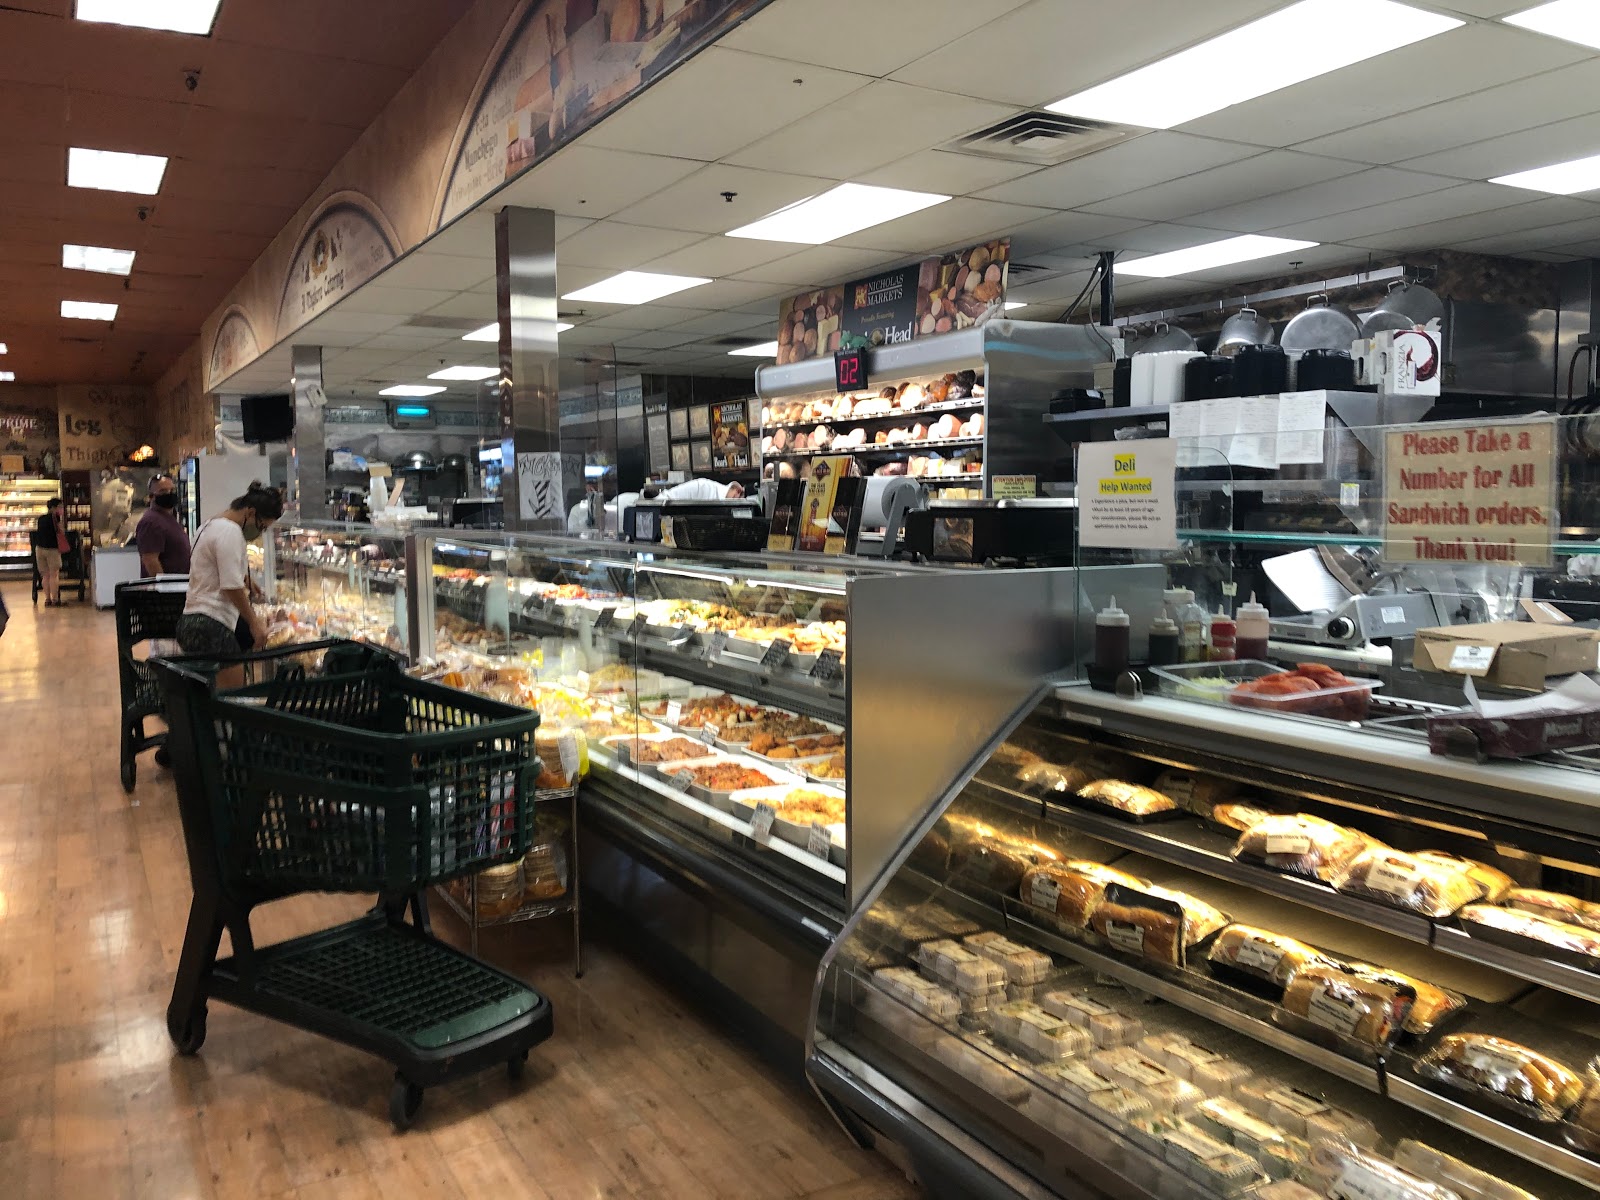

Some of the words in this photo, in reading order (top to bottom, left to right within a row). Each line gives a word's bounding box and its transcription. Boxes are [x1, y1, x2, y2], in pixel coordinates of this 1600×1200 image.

[464, 133, 499, 172] Manchego
[868, 274, 904, 292] NICHOLAS
[866, 288, 903, 306] MARKETS
[885, 321, 912, 344] Head
[840, 357, 858, 384] 02
[1398, 344, 1406, 389] FRANZIA
[721, 403, 743, 412] NICHOLAS
[721, 413, 743, 422] MARKETS
[0, 417, 37, 428] PRIME
[65, 414, 102, 436] Leg
[1403, 433, 1459, 455] Please
[1464, 429, 1511, 452] Take
[1517, 431, 1531, 450] a
[734, 454, 748, 467] Head
[1114, 459, 1135, 472] Deli
[1101, 483, 1118, 492] Help
[1120, 481, 1152, 491] Wanted
[1400, 466, 1467, 490] Number
[1474, 465, 1503, 488] for
[1509, 463, 1535, 487] All
[1388, 502, 1470, 525] Sandwich
[1475, 501, 1547, 525] orders.
[1413, 536, 1467, 560] Thank
[1472, 537, 1516, 561] You!
